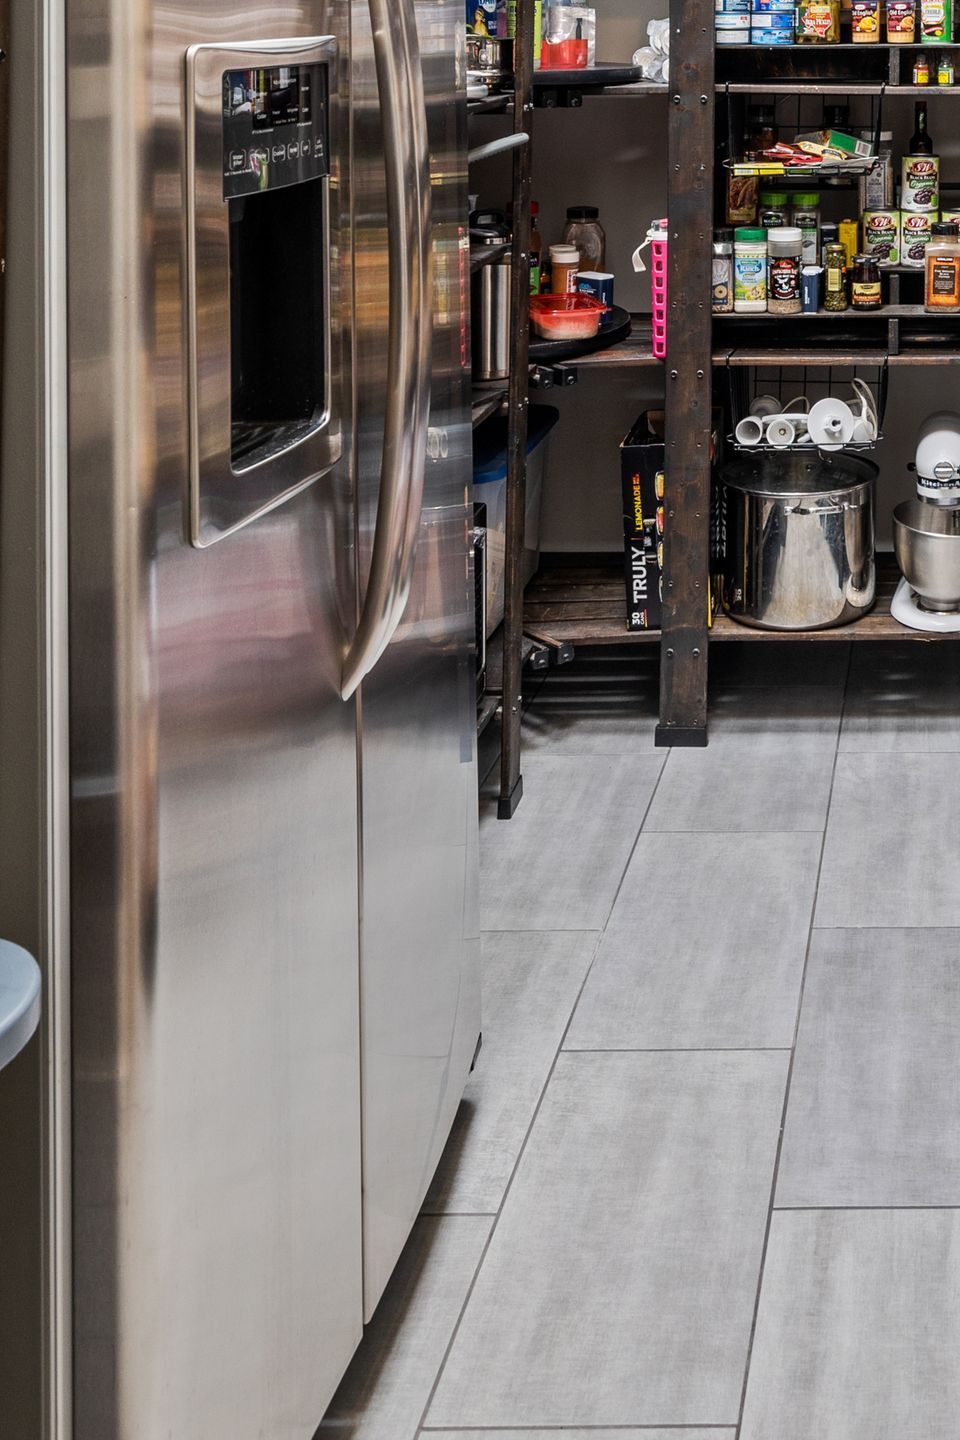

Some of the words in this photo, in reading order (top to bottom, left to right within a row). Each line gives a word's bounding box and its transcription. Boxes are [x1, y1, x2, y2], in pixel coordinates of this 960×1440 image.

[632, 484, 643, 531] LEMONADE
[630, 545, 648, 603] TRULY
[631, 612, 640, 625] 30
